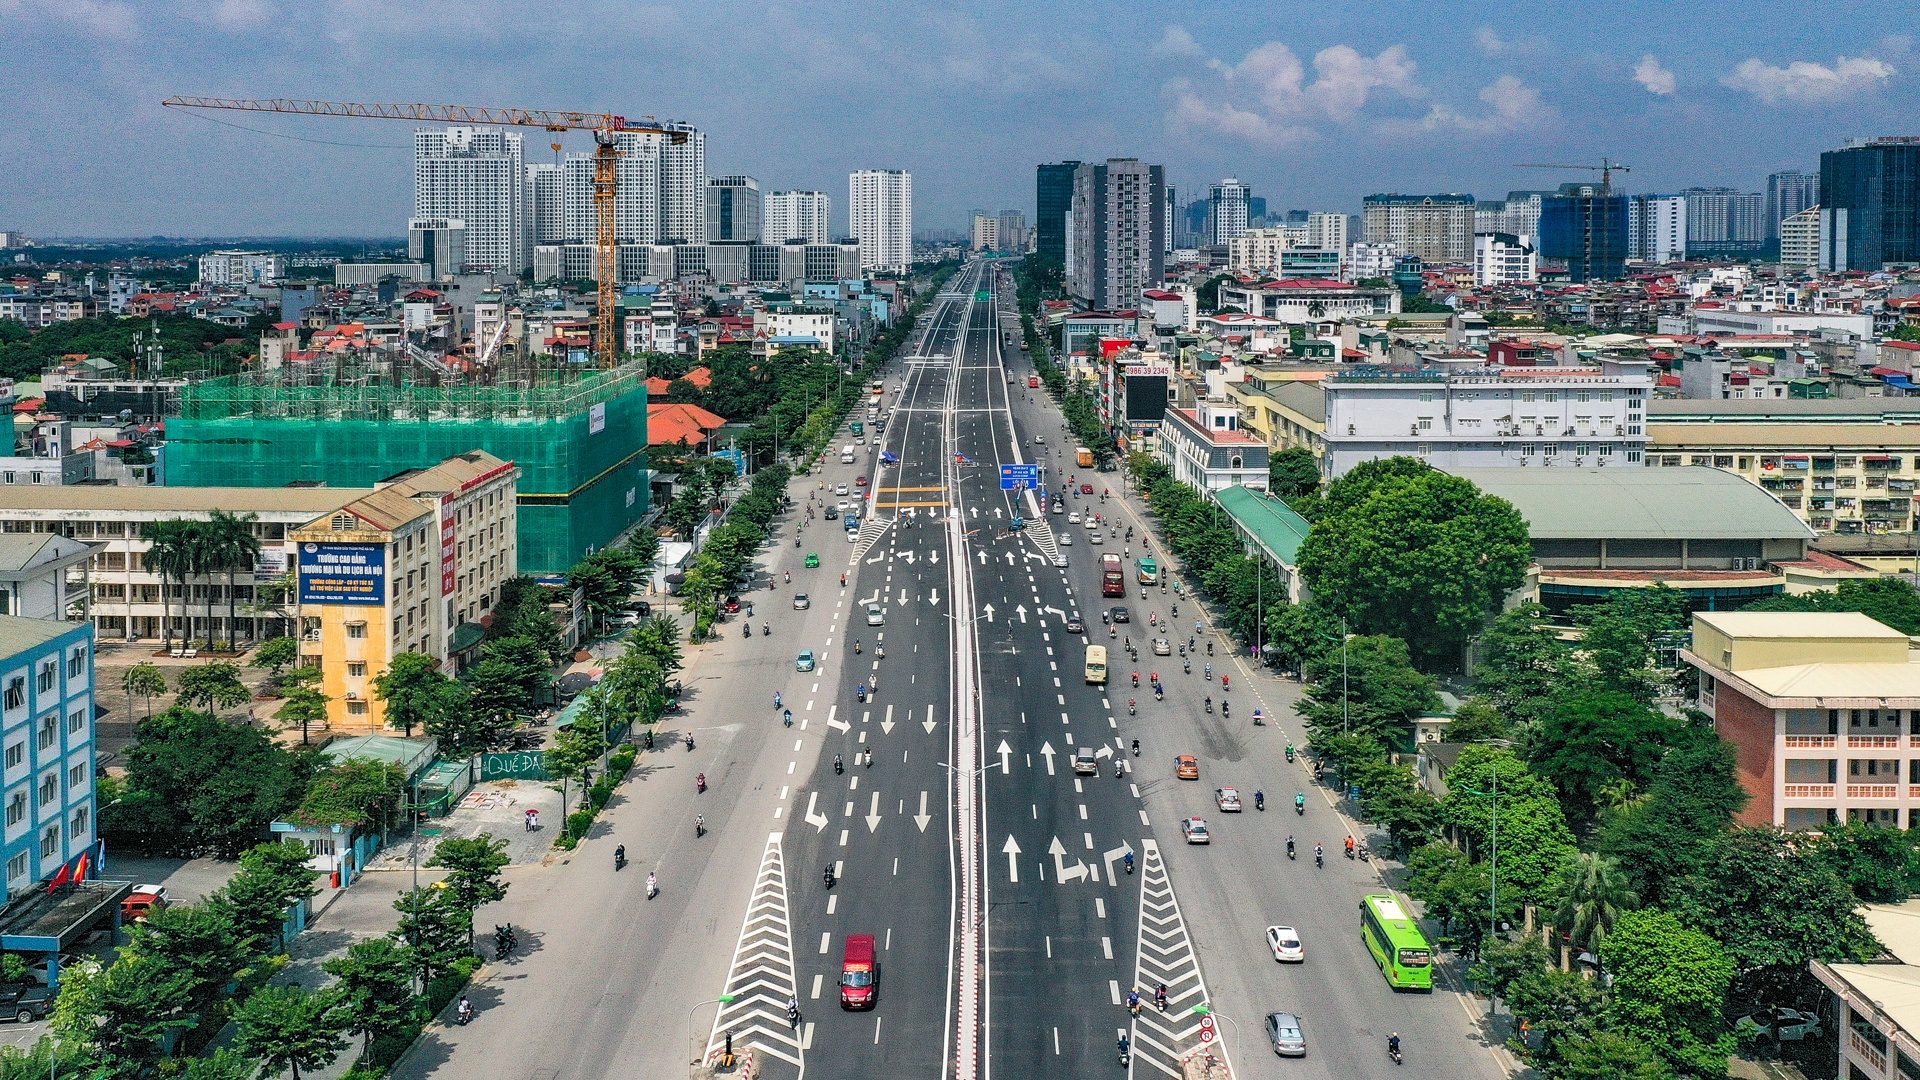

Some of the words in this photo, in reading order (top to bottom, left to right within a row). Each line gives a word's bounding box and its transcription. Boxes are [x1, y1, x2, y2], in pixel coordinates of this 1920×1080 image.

[317, 553, 338, 563] TRƯỜNG
[340, 555, 350, 563] CAO
[351, 552, 366, 564] ĐẲNG
[301, 565, 322, 573] THƯƠNG
[323, 566, 333, 575] MẠI
[334, 564, 342, 574] VÀ
[343, 566, 350, 574] DU
[352, 566, 363, 575] LỊCH
[364, 565, 372, 574] HÀ
[373, 565, 382, 576] NỘI
